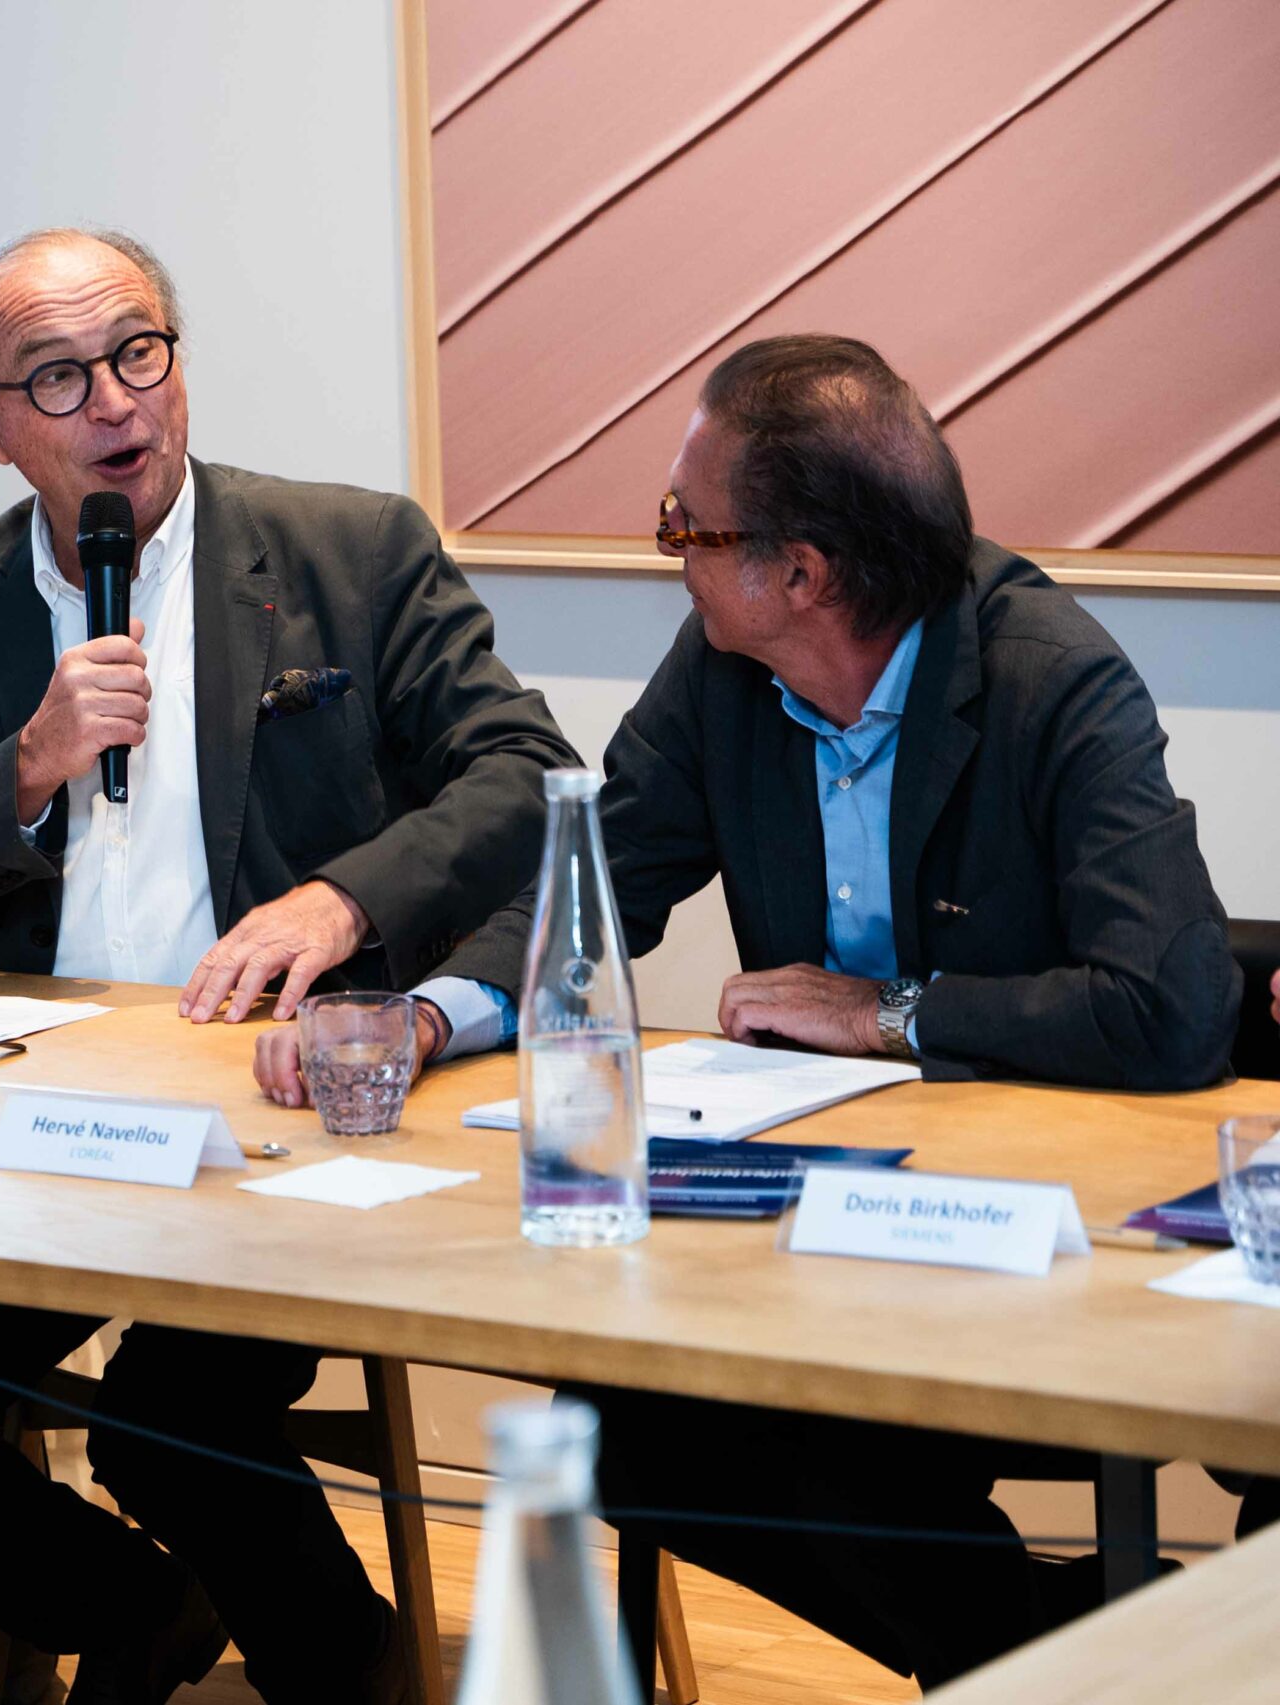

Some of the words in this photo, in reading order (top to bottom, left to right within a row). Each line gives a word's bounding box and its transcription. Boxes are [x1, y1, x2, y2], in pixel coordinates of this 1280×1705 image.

[32, 1115, 86, 1137] Hervé
[90, 1122, 170, 1145] Navellou
[845, 1193, 902, 1215] Doris
[909, 1196, 1014, 1225] Birkhofer
